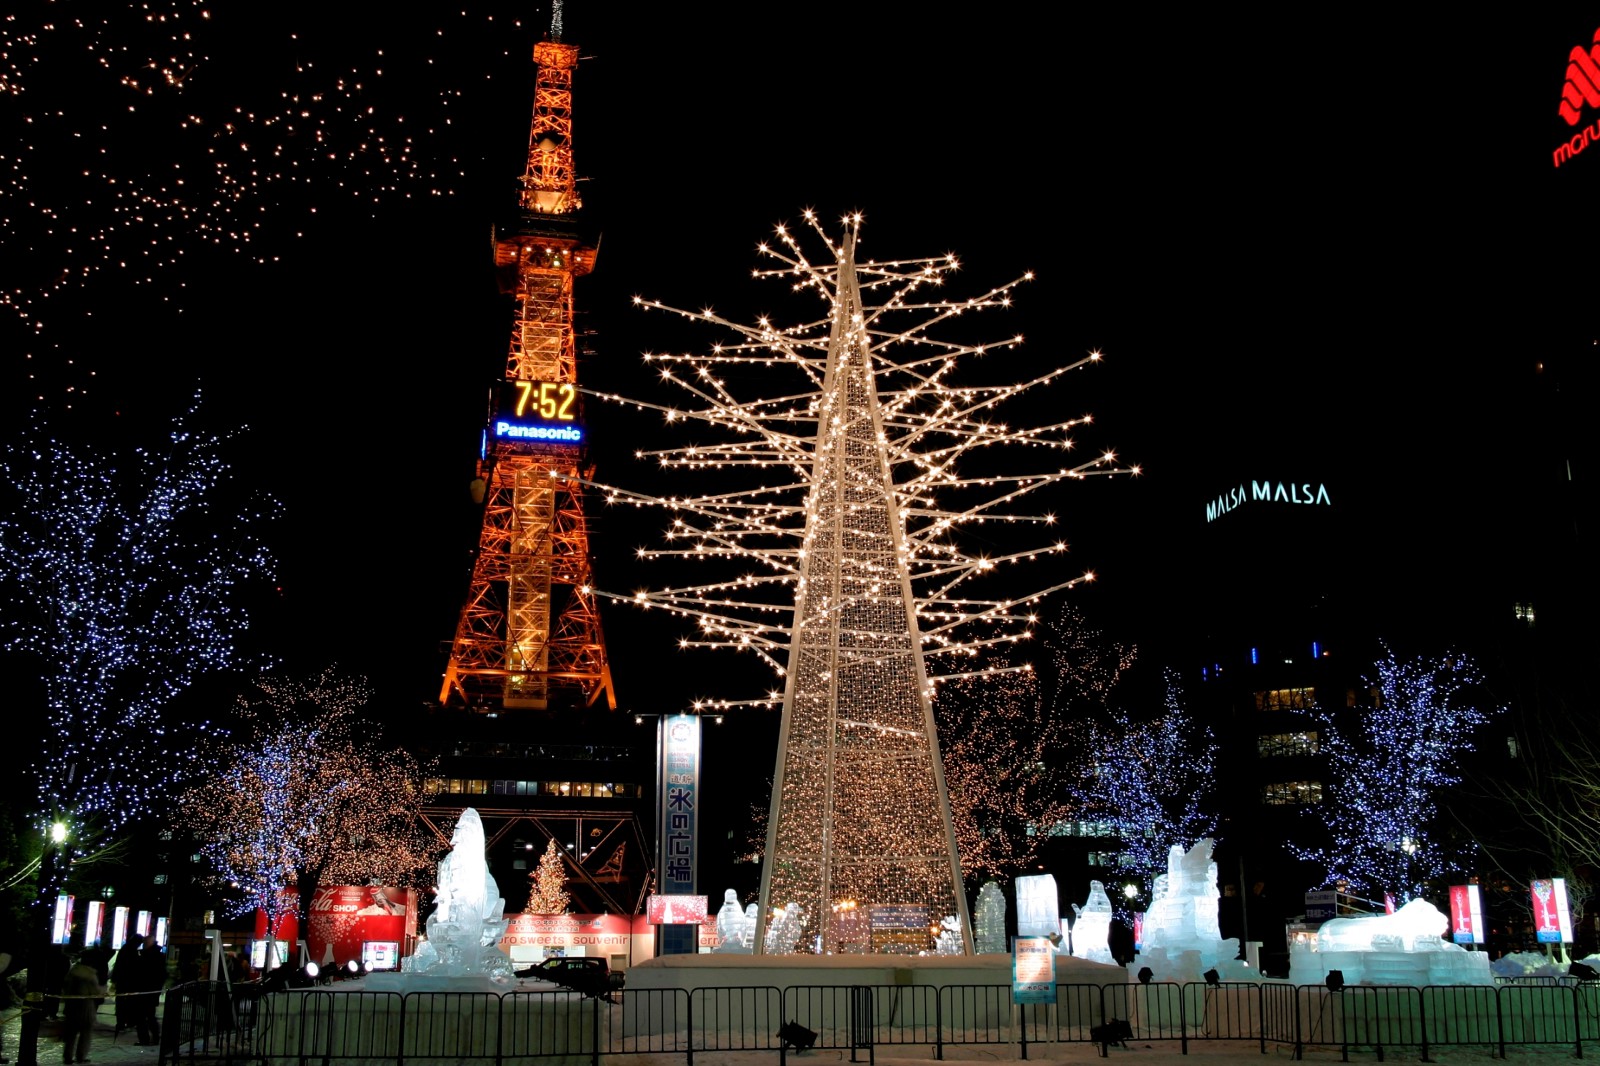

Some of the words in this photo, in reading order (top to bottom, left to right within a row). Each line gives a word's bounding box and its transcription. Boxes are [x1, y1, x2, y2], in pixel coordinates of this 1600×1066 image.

[516, 381, 575, 420] 7:52
[496, 421, 581, 441] Panasonic
[1206, 483, 1247, 523] MALSA
[1252, 480, 1331, 506] MALSA
[666, 788, 694, 883] 氷の広場
[332, 904, 358, 912] SHOP
[519, 936, 565, 945] sweets
[573, 935, 628, 945] souvenir
